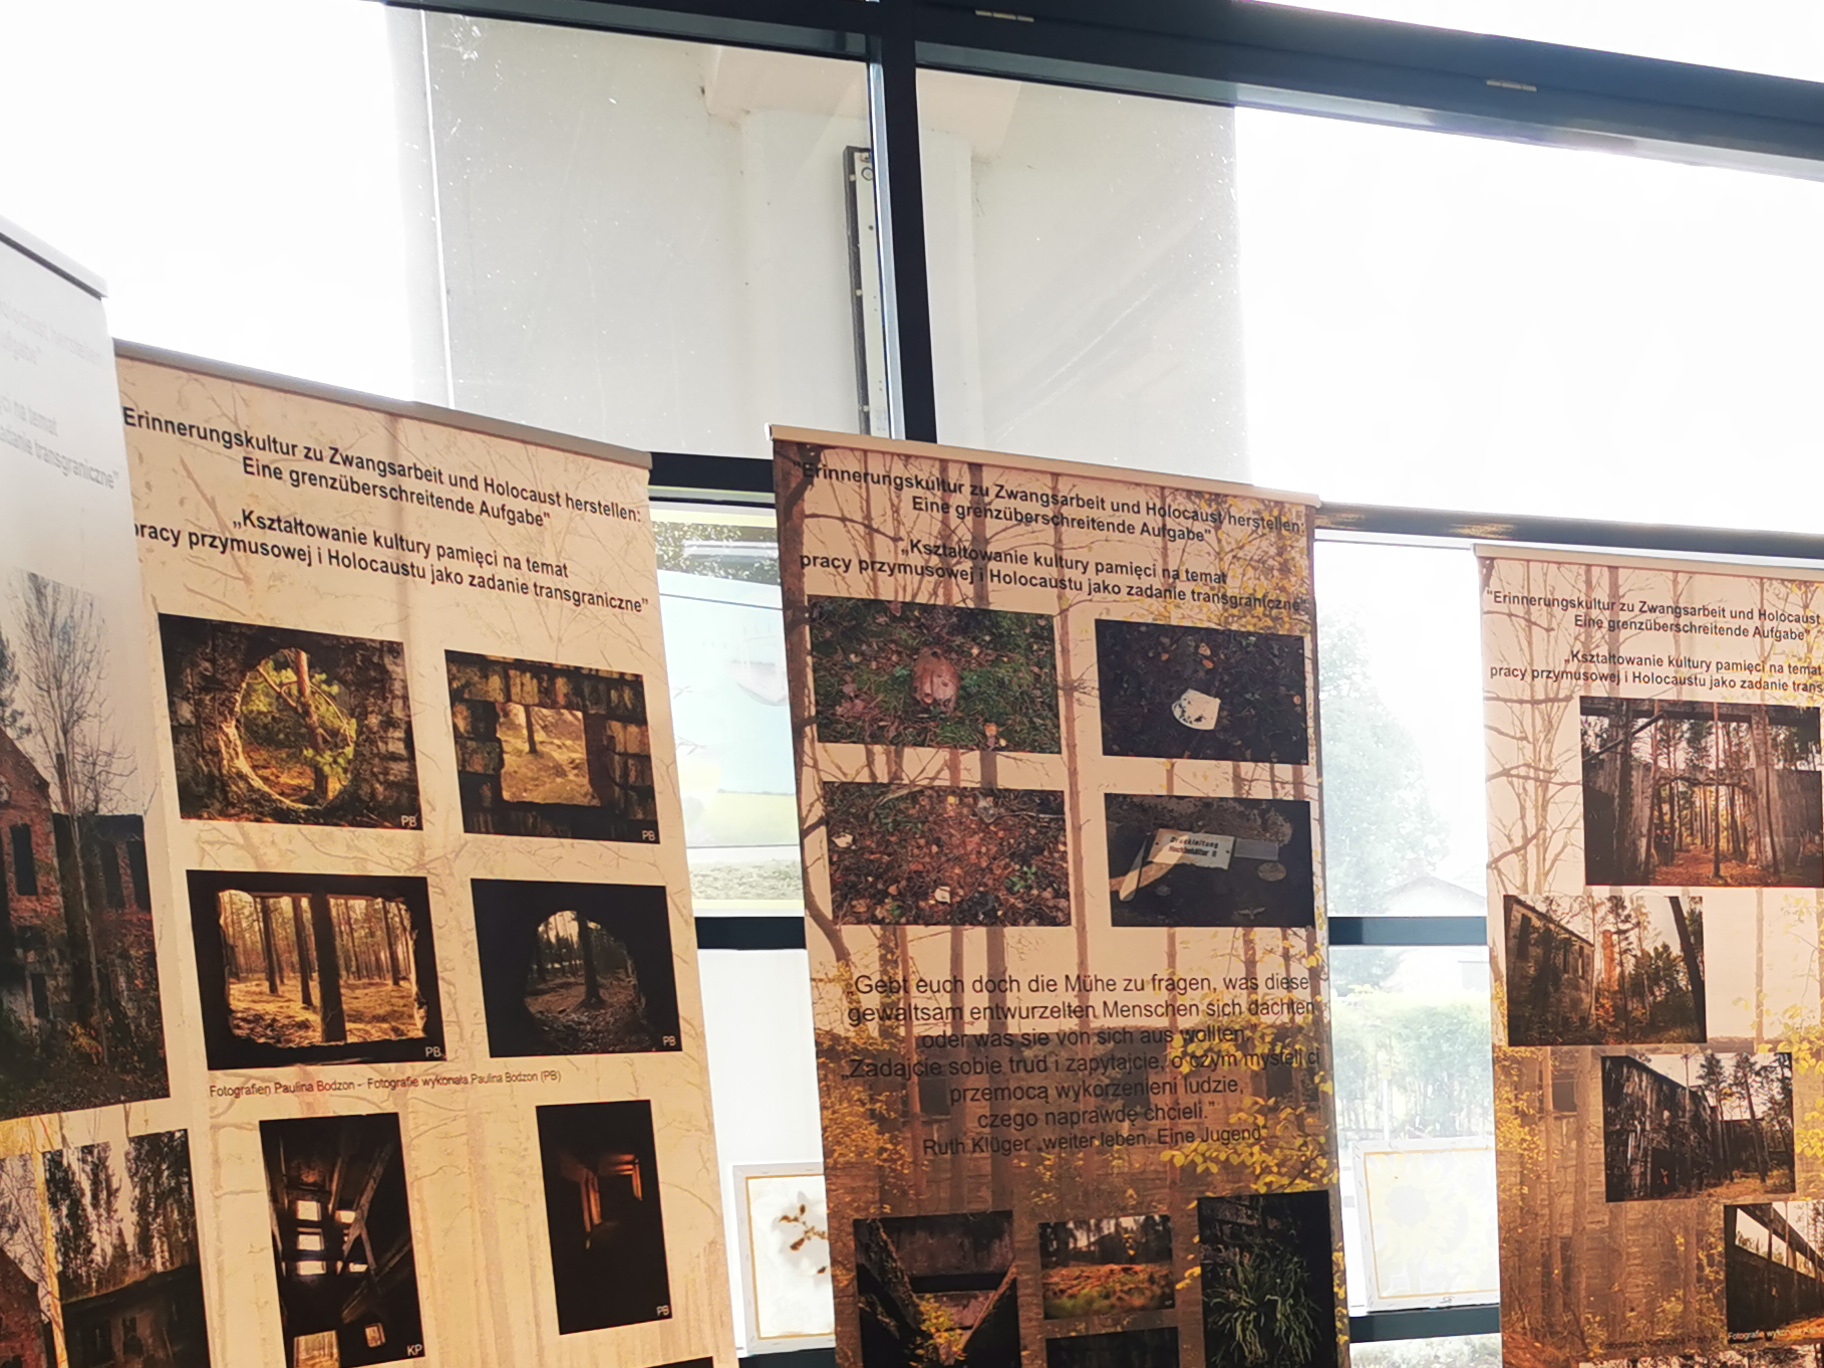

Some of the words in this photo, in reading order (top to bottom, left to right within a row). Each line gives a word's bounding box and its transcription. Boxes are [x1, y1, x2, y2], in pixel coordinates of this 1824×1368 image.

[243, 456, 282, 479] Eine
[289, 469, 473, 513] grenzüberschreitende
[304, 444, 323, 461] zu
[329, 445, 443, 484] Zwangsarbeit
[449, 473, 478, 490] und
[484, 476, 561, 506] Holocaust
[565, 492, 640, 521] herstellen:
[189, 533, 310, 567] przymusowej
[317, 548, 321, 564] i
[328, 550, 424, 579] Holocaustu
[430, 565, 462, 585] jako
[468, 574, 528, 594] zadanie
[373, 531, 430, 559] kultury
[437, 545, 497, 568] pamięci
[503, 556, 520, 570] na
[526, 557, 568, 577] temat
[1574, 614, 1603, 627] Eine
[1608, 619, 1747, 636] grenzüberschreitende
[1619, 602, 1634, 612] zu
[1639, 601, 1725, 618] Zwangsarbeit
[1730, 608, 1753, 620] und
[1759, 609, 1819, 624] Holocaust
[1667, 656, 1710, 673] kultury
[1716, 660, 1764, 675] pamięci
[1770, 665, 1783, 674] na
[1788, 664, 1821, 676] temat
[1490, 668, 1526, 681] pracy
[1532, 670, 1620, 686] przymusowej
[1625, 672, 1628, 683] i
[1633, 673, 1706, 687] Holocaustu
[1709, 676, 1736, 690] jako
[1740, 679, 1787, 691] zadanie
[401, 814, 417, 827] PB
[915, 975, 964, 993] euch
[972, 974, 1020, 992] doch
[1028, 974, 1057, 992] die
[1065, 974, 1115, 991] Mühe
[1123, 978, 1144, 991] zu
[1152, 974, 1216, 995] fragen,
[1223, 977, 1258, 990] was
[1265, 973, 1309, 989] diese
[848, 1002, 963, 1026] gewaltsam
[970, 1001, 1096, 1019] entwurzelten
[1103, 1000, 1198, 1017] Menschen
[1206, 999, 1242, 1015] sich
[1250, 998, 1314, 1015] dachten
[922, 1029, 968, 1048] oder
[975, 1033, 1014, 1047] was
[1021, 1028, 1050, 1046] sie
[1056, 1032, 1088, 1045] von
[1097, 1027, 1132, 1045] sich
[1140, 1030, 1174, 1044] aus
[950, 1086, 1049, 1106] przemocą
[1054, 1079, 1177, 1102] wykorzenieni
[1184, 1077, 1244, 1097] ludzie,
[978, 1113, 1037, 1131] czego
[1045, 1106, 1137, 1129] naprawdę
[924, 1138, 966, 1155] Ruth
[972, 1136, 1031, 1156] Klüger
[1100, 1131, 1150, 1147] leben.
[1157, 1129, 1194, 1145] Eine
